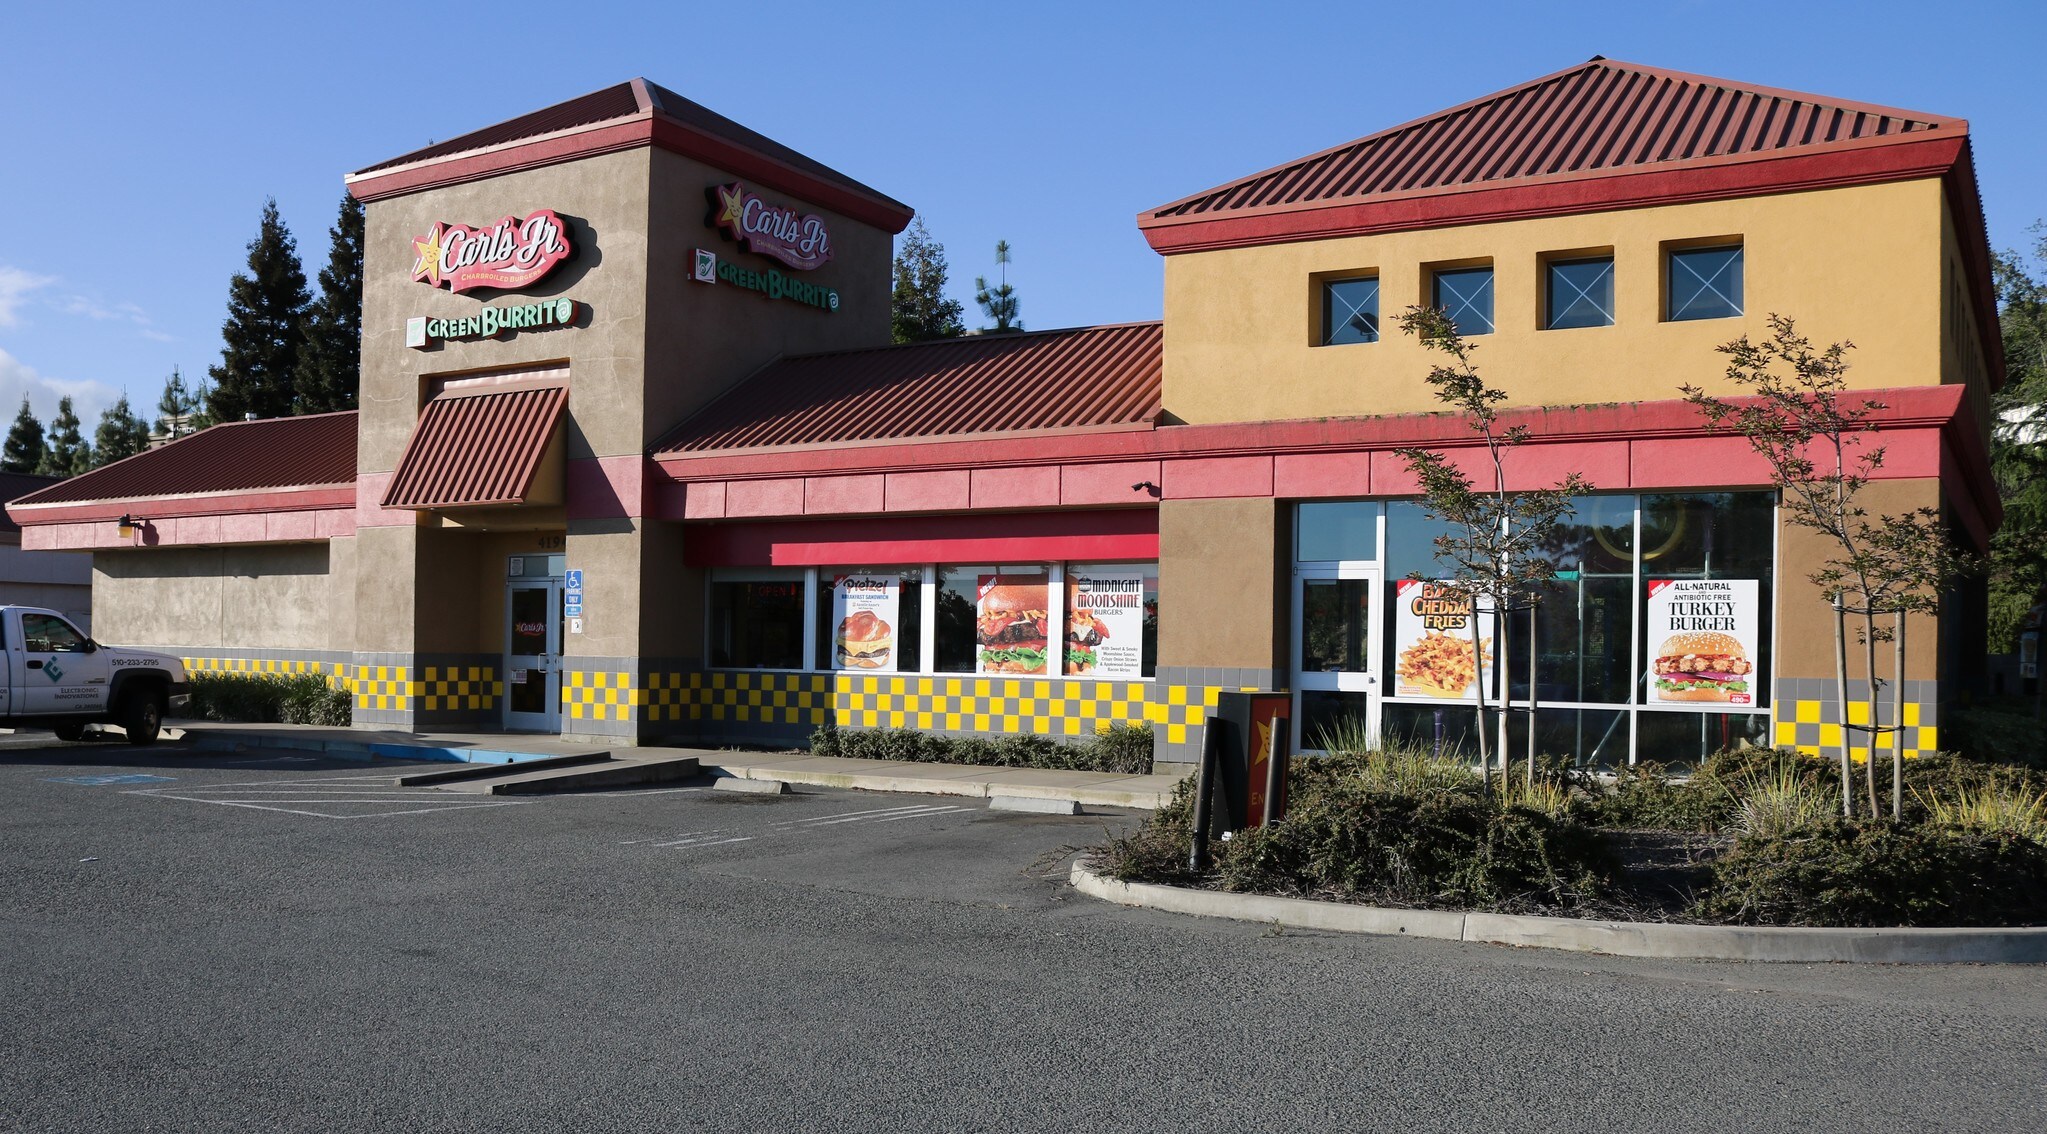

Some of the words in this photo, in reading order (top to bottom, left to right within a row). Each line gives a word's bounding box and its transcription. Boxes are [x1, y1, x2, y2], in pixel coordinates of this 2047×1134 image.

[742, 198, 800, 243] Carl's
[439, 220, 518, 273] Carl's
[517, 216, 564, 263] Jr.
[461, 273, 509, 282] CHARBROILED
[509, 269, 542, 283] BURGERS
[843, 577, 888, 594] Pretzel
[979, 576, 998, 597] NEW!
[1092, 579, 1140, 593] MIDNIGHT
[1674, 583, 1731, 591] ALL-NATURAL
[1077, 594, 1140, 608] MOONSHINE
[1668, 602, 1736, 616] TURKEY
[1424, 615, 1467, 630] FRIES
[1669, 617, 1735, 630] BURGER
[111, 658, 160, 666] 510-233-2795
